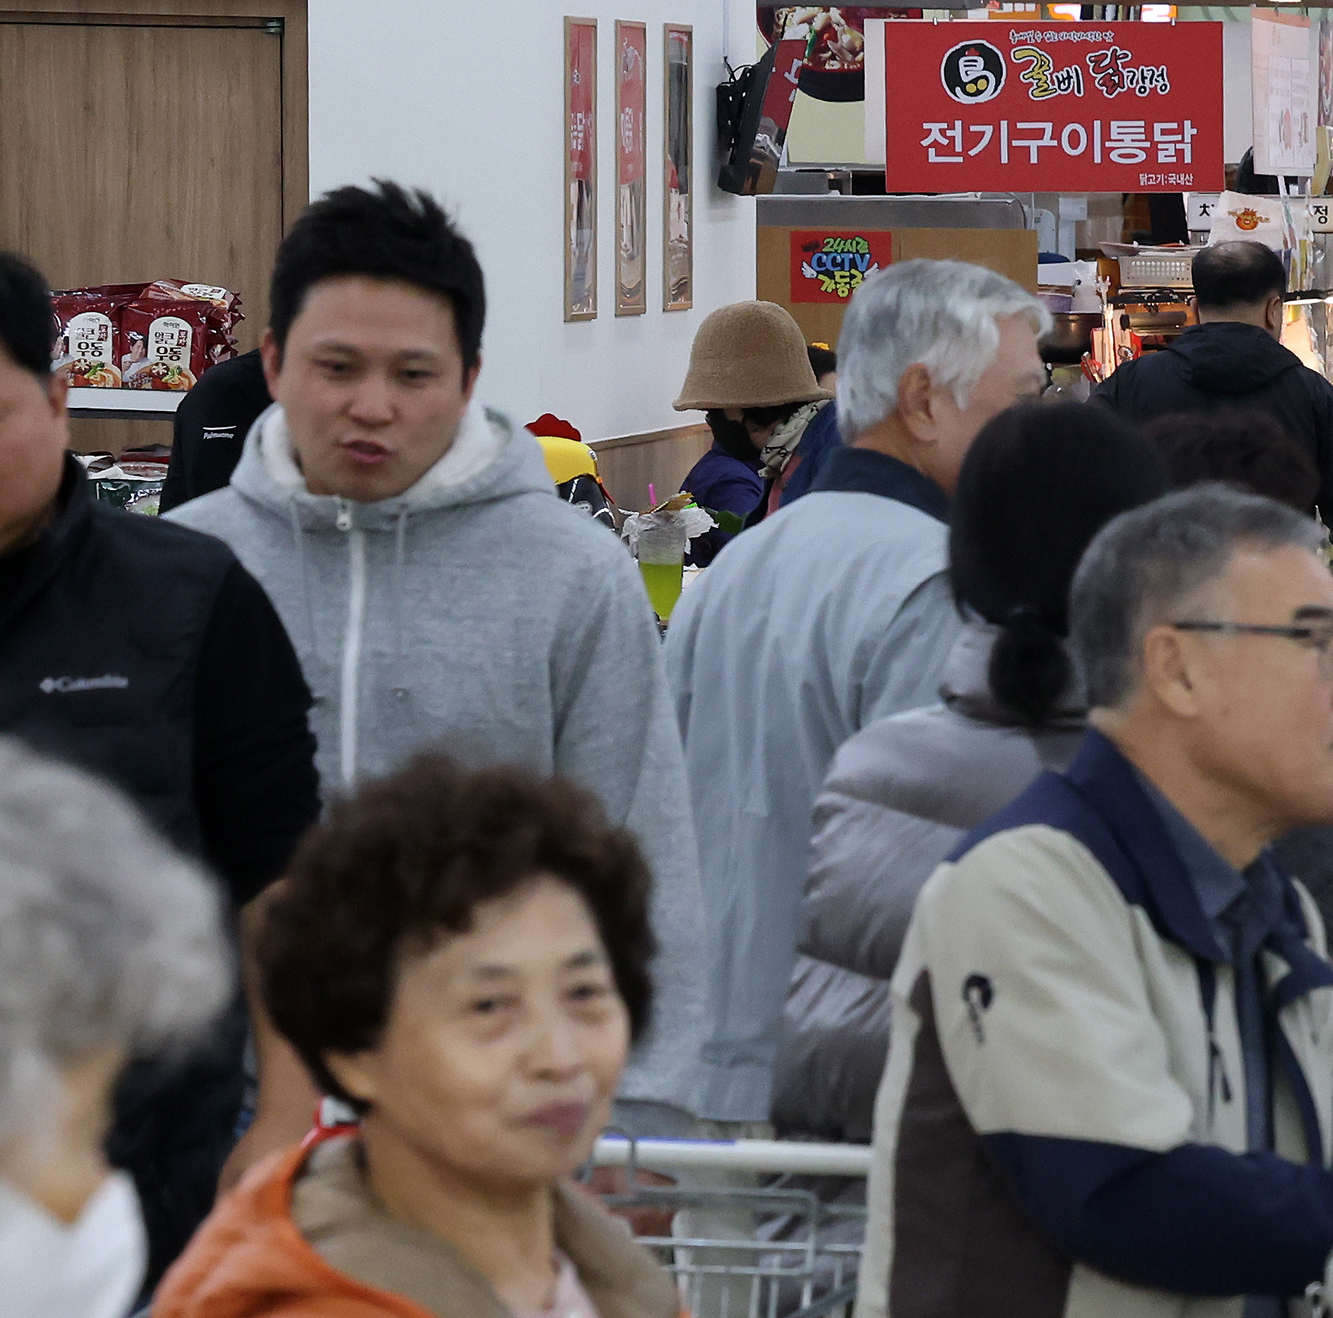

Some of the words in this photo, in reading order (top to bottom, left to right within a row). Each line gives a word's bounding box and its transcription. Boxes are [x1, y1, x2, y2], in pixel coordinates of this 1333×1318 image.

[1087, 46, 1170, 97] 닭강정
[920, 119, 1198, 165] 전기구이통닭
[811, 252, 871, 272] CCTV
[76, 341, 104, 358] 우동
[155, 346, 182, 362] 우동
